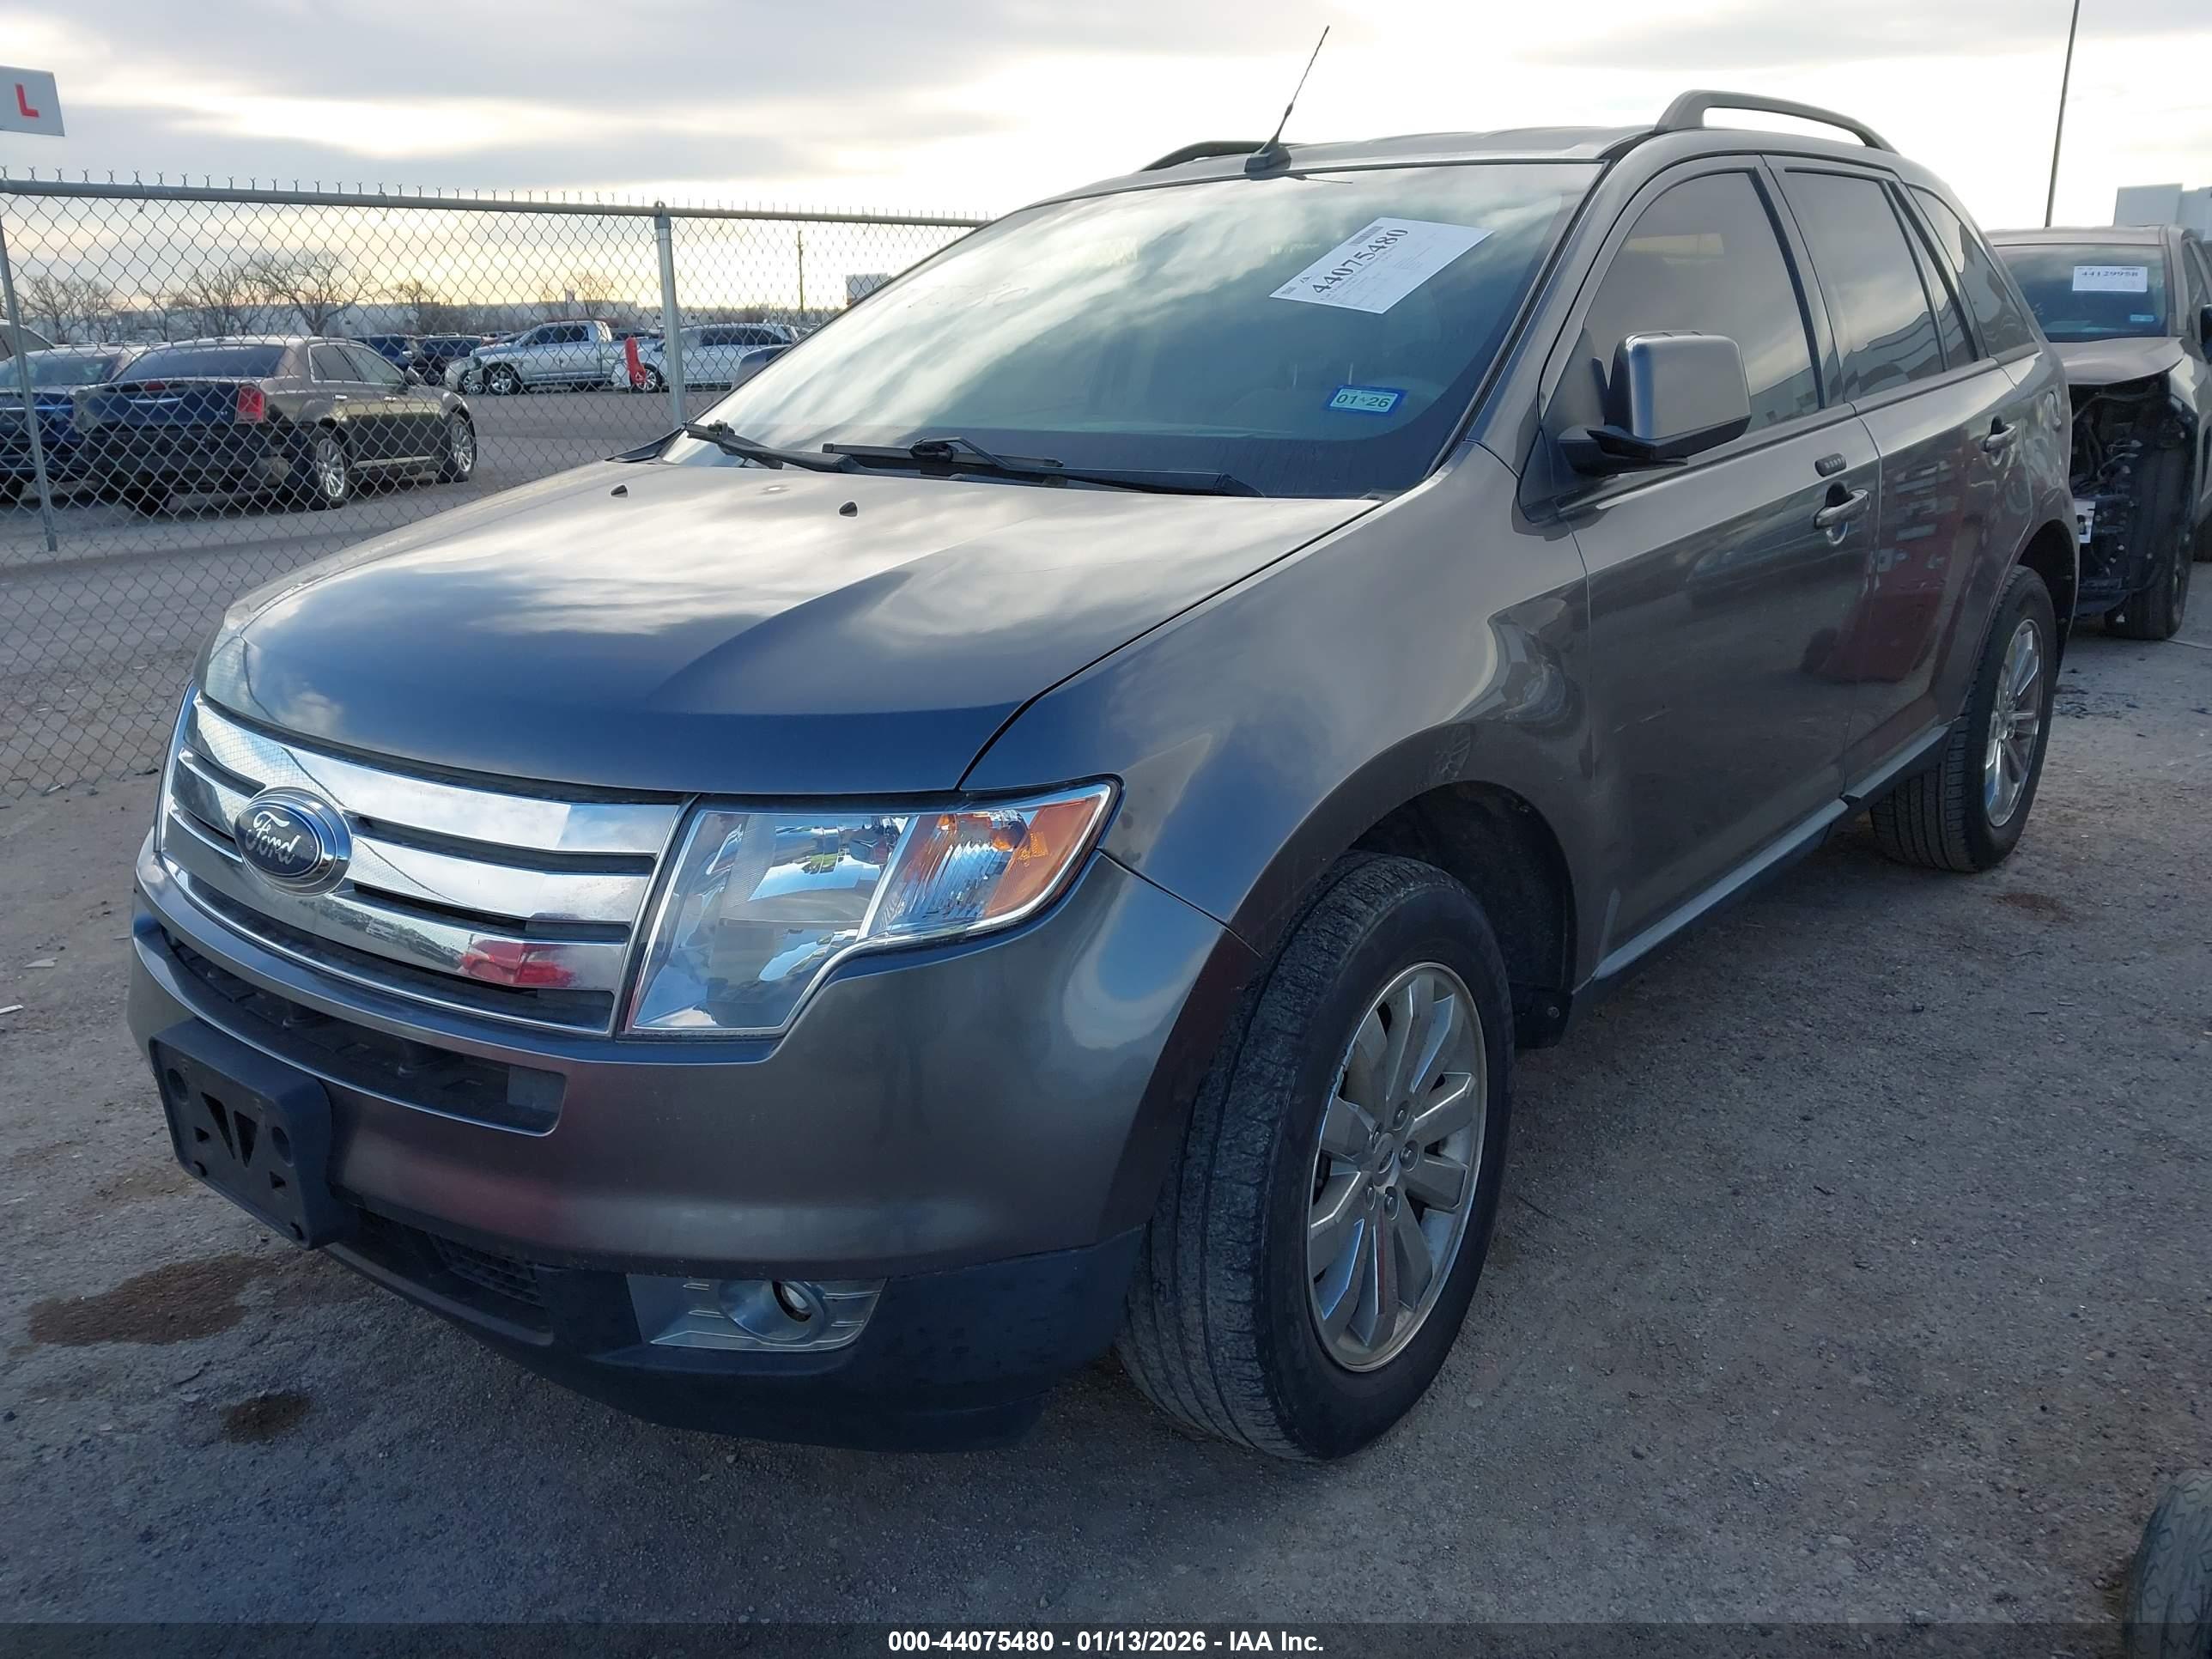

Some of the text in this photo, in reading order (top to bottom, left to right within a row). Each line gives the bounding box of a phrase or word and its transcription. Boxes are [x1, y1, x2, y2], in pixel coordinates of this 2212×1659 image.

[15, 83, 40, 118] L
[1312, 229, 1408, 294] 44075480
[245, 811, 302, 866] Ford
